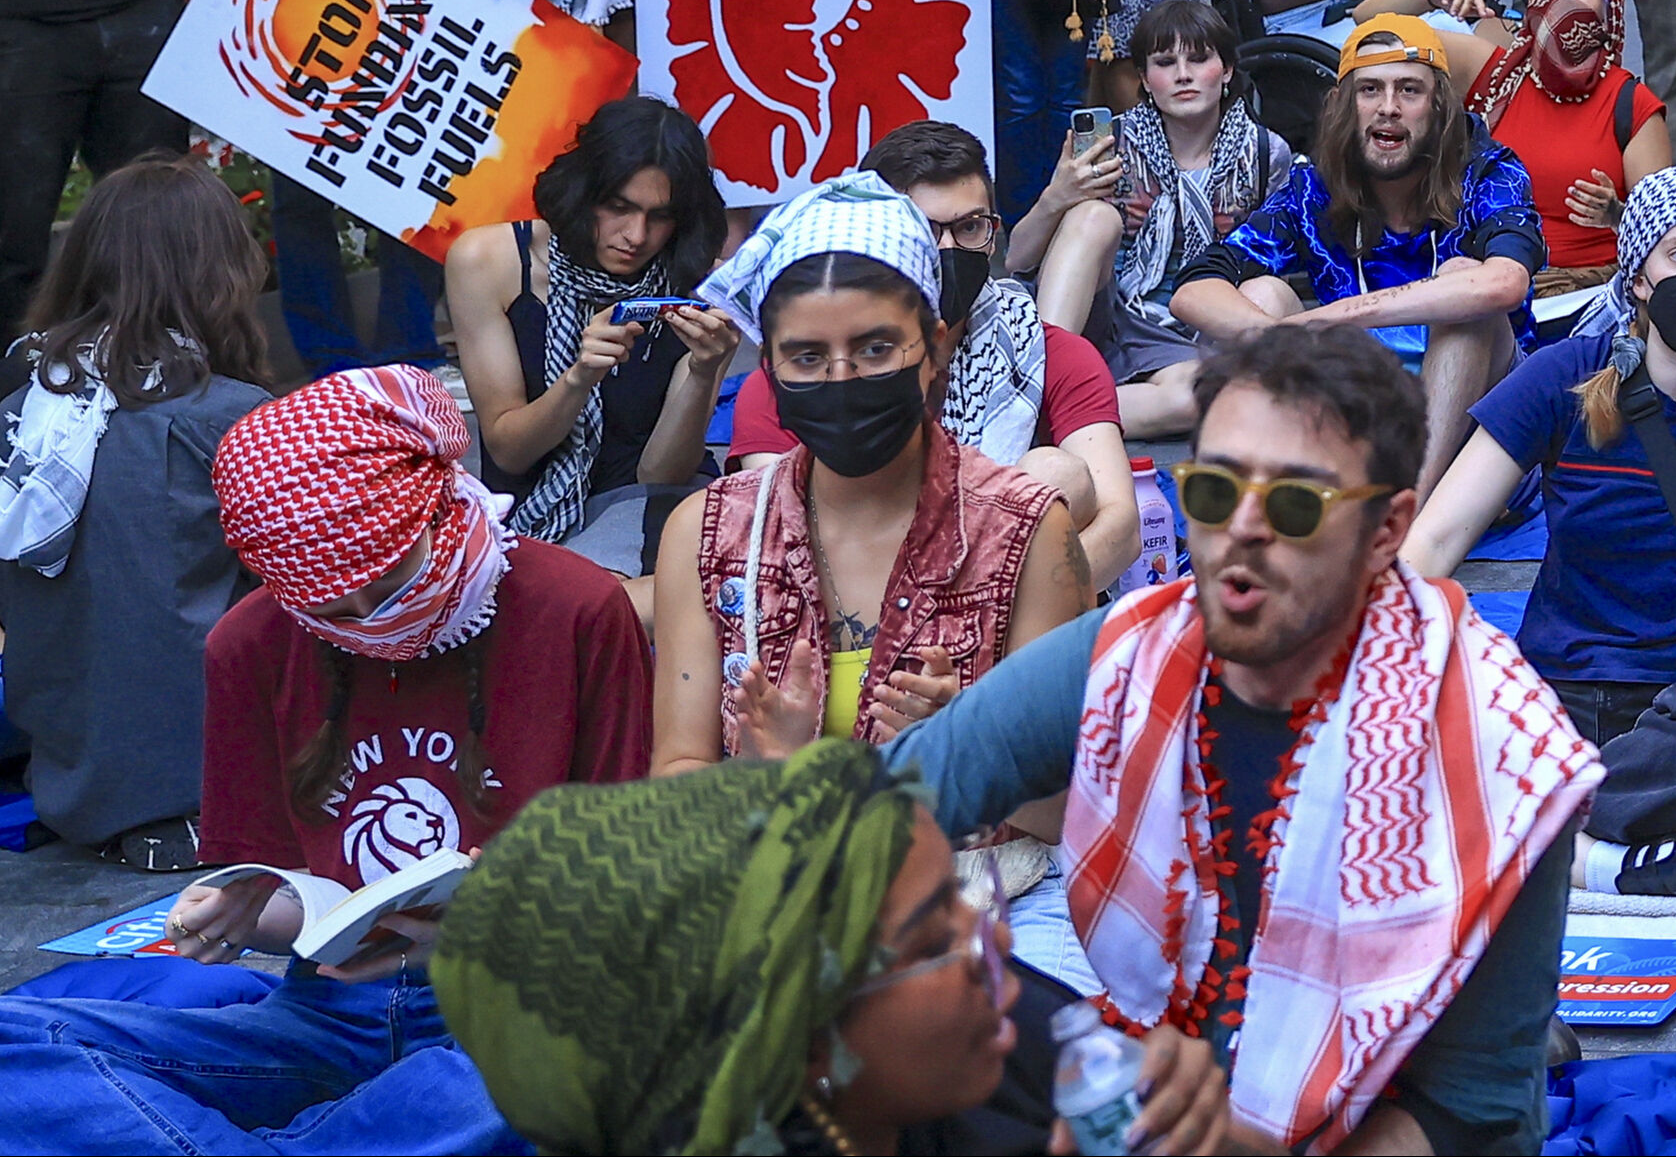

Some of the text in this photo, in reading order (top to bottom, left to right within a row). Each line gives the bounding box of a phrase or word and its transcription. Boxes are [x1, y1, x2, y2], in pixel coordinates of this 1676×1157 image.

[366, 16, 484, 188] FOSSIL
[417, 41, 523, 206] FUELS
[1143, 535, 1168, 549] KEFIR
